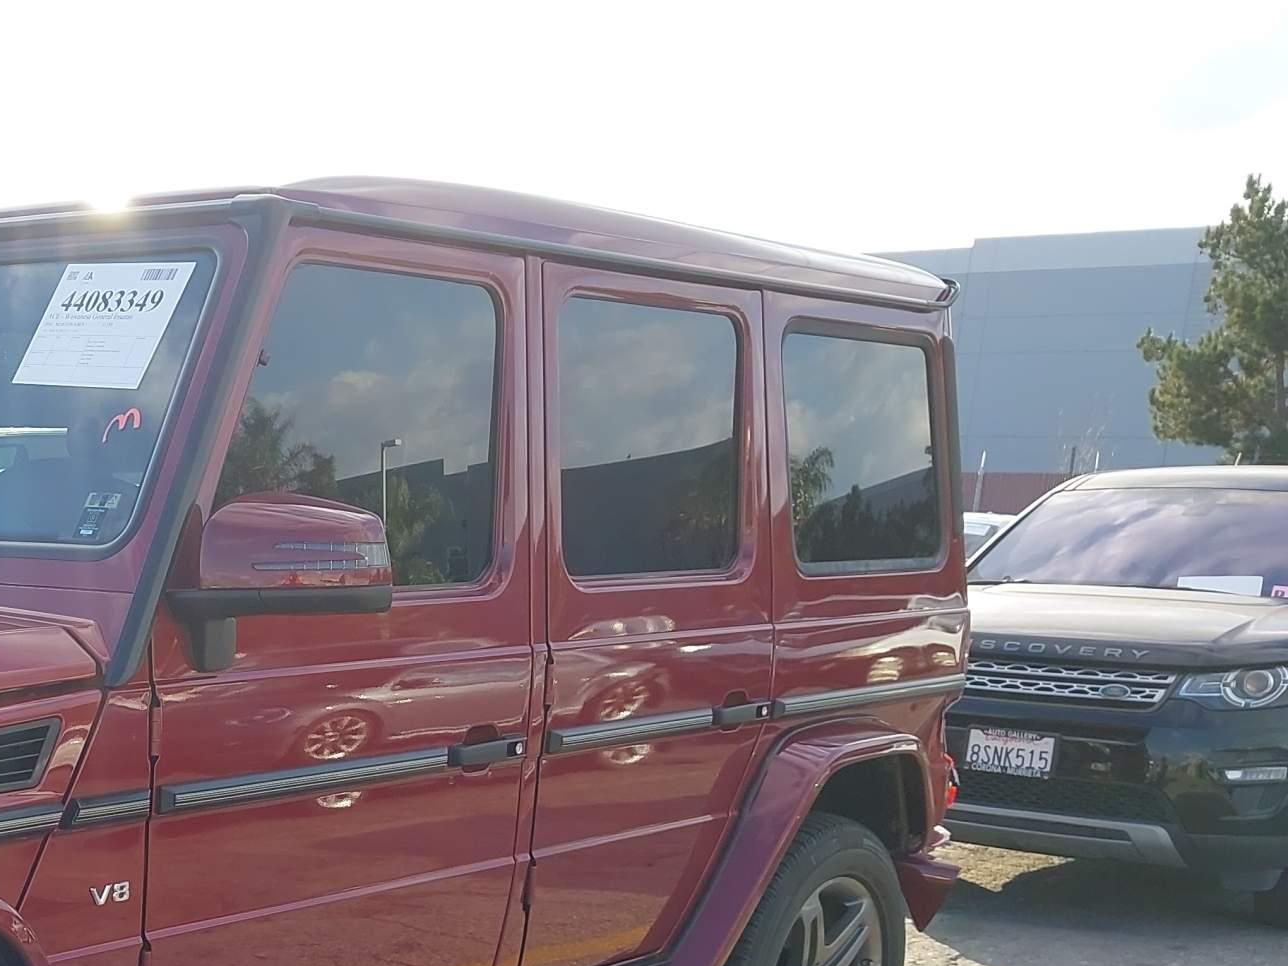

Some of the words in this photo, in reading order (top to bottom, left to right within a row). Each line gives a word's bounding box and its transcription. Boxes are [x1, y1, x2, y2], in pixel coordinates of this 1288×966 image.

[61, 289, 164, 313] 44083349
[979, 638, 1150, 660] SCOVERY
[969, 743, 1049, 771] 8SNK515
[89, 881, 130, 906] V8
